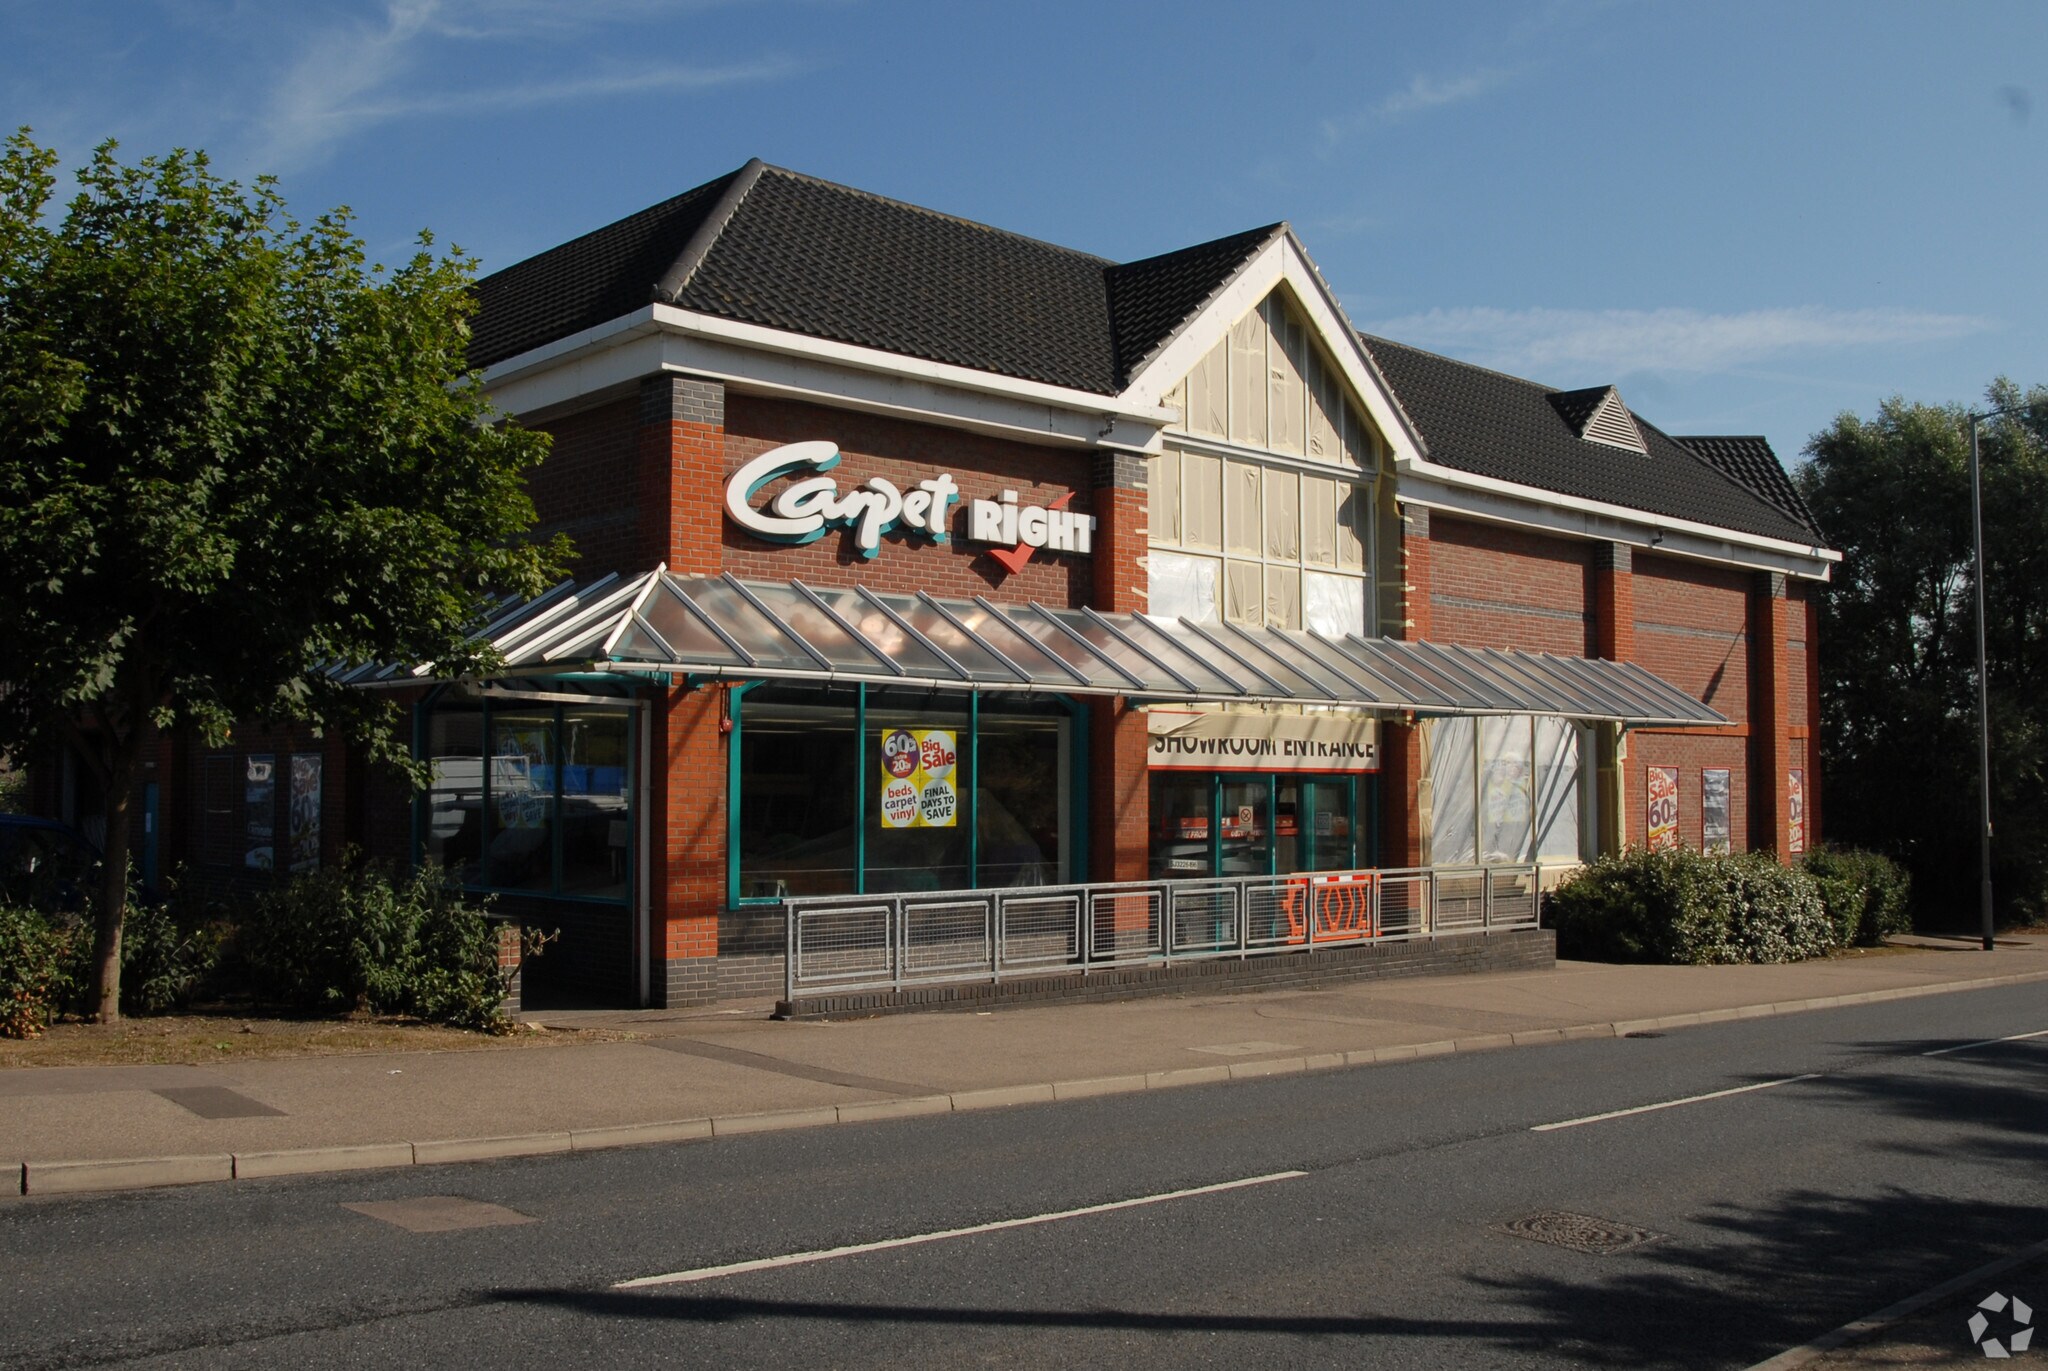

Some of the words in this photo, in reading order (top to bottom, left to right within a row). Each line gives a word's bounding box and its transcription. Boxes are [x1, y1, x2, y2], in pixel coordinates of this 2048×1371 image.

[725, 440, 959, 558] Carpet
[921, 739, 940, 754] Big
[1154, 736, 1276, 756] SHOWROOM
[921, 749, 955, 771] Sale
[1649, 768, 1664, 784] Big
[888, 785, 912, 798] beds
[924, 786, 949, 798] FINAL
[1649, 778, 1675, 801] Sale
[885, 795, 917, 810] carpet
[921, 798, 942, 809] DAYS
[944, 795, 955, 805] TO
[890, 806, 915, 820] vinyl
[926, 806, 951, 820] SAVE
